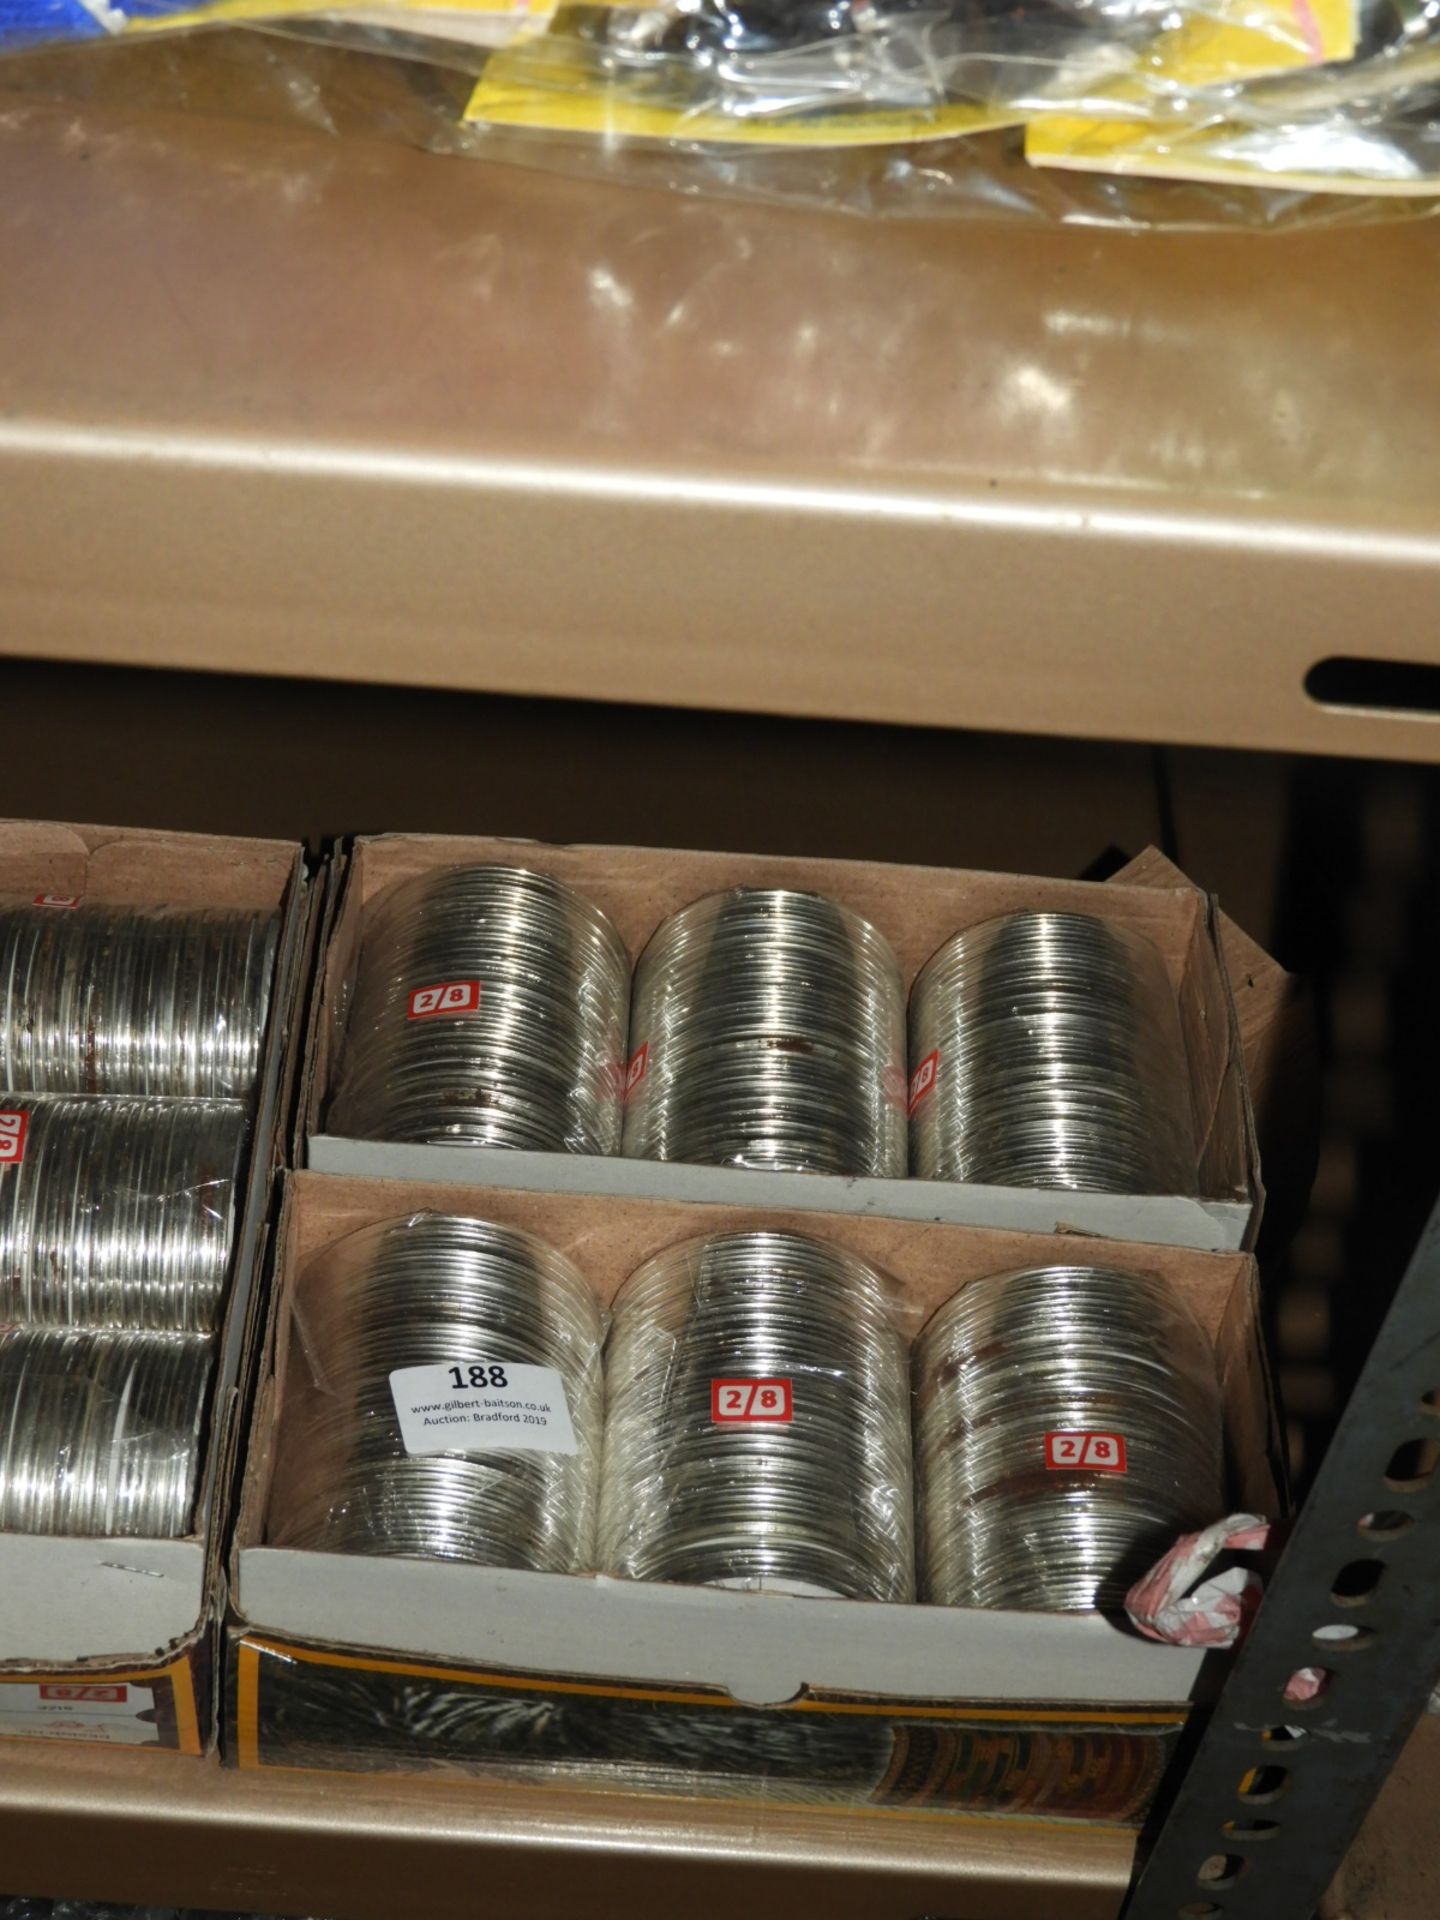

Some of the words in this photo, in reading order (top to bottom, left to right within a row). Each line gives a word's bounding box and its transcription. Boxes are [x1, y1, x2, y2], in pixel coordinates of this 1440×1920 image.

[417, 984, 466, 1012] 2/8
[448, 1365, 508, 1389] 188
[412, 1399, 552, 1414] www.gilbert-baitson.co.uk
[724, 1386, 779, 1415] 2/8
[423, 1414, 470, 1426] Auction:
[473, 1413, 521, 1423] Bradford
[523, 1414, 548, 1426] 2019
[1058, 1436, 1112, 1464] 2/8
